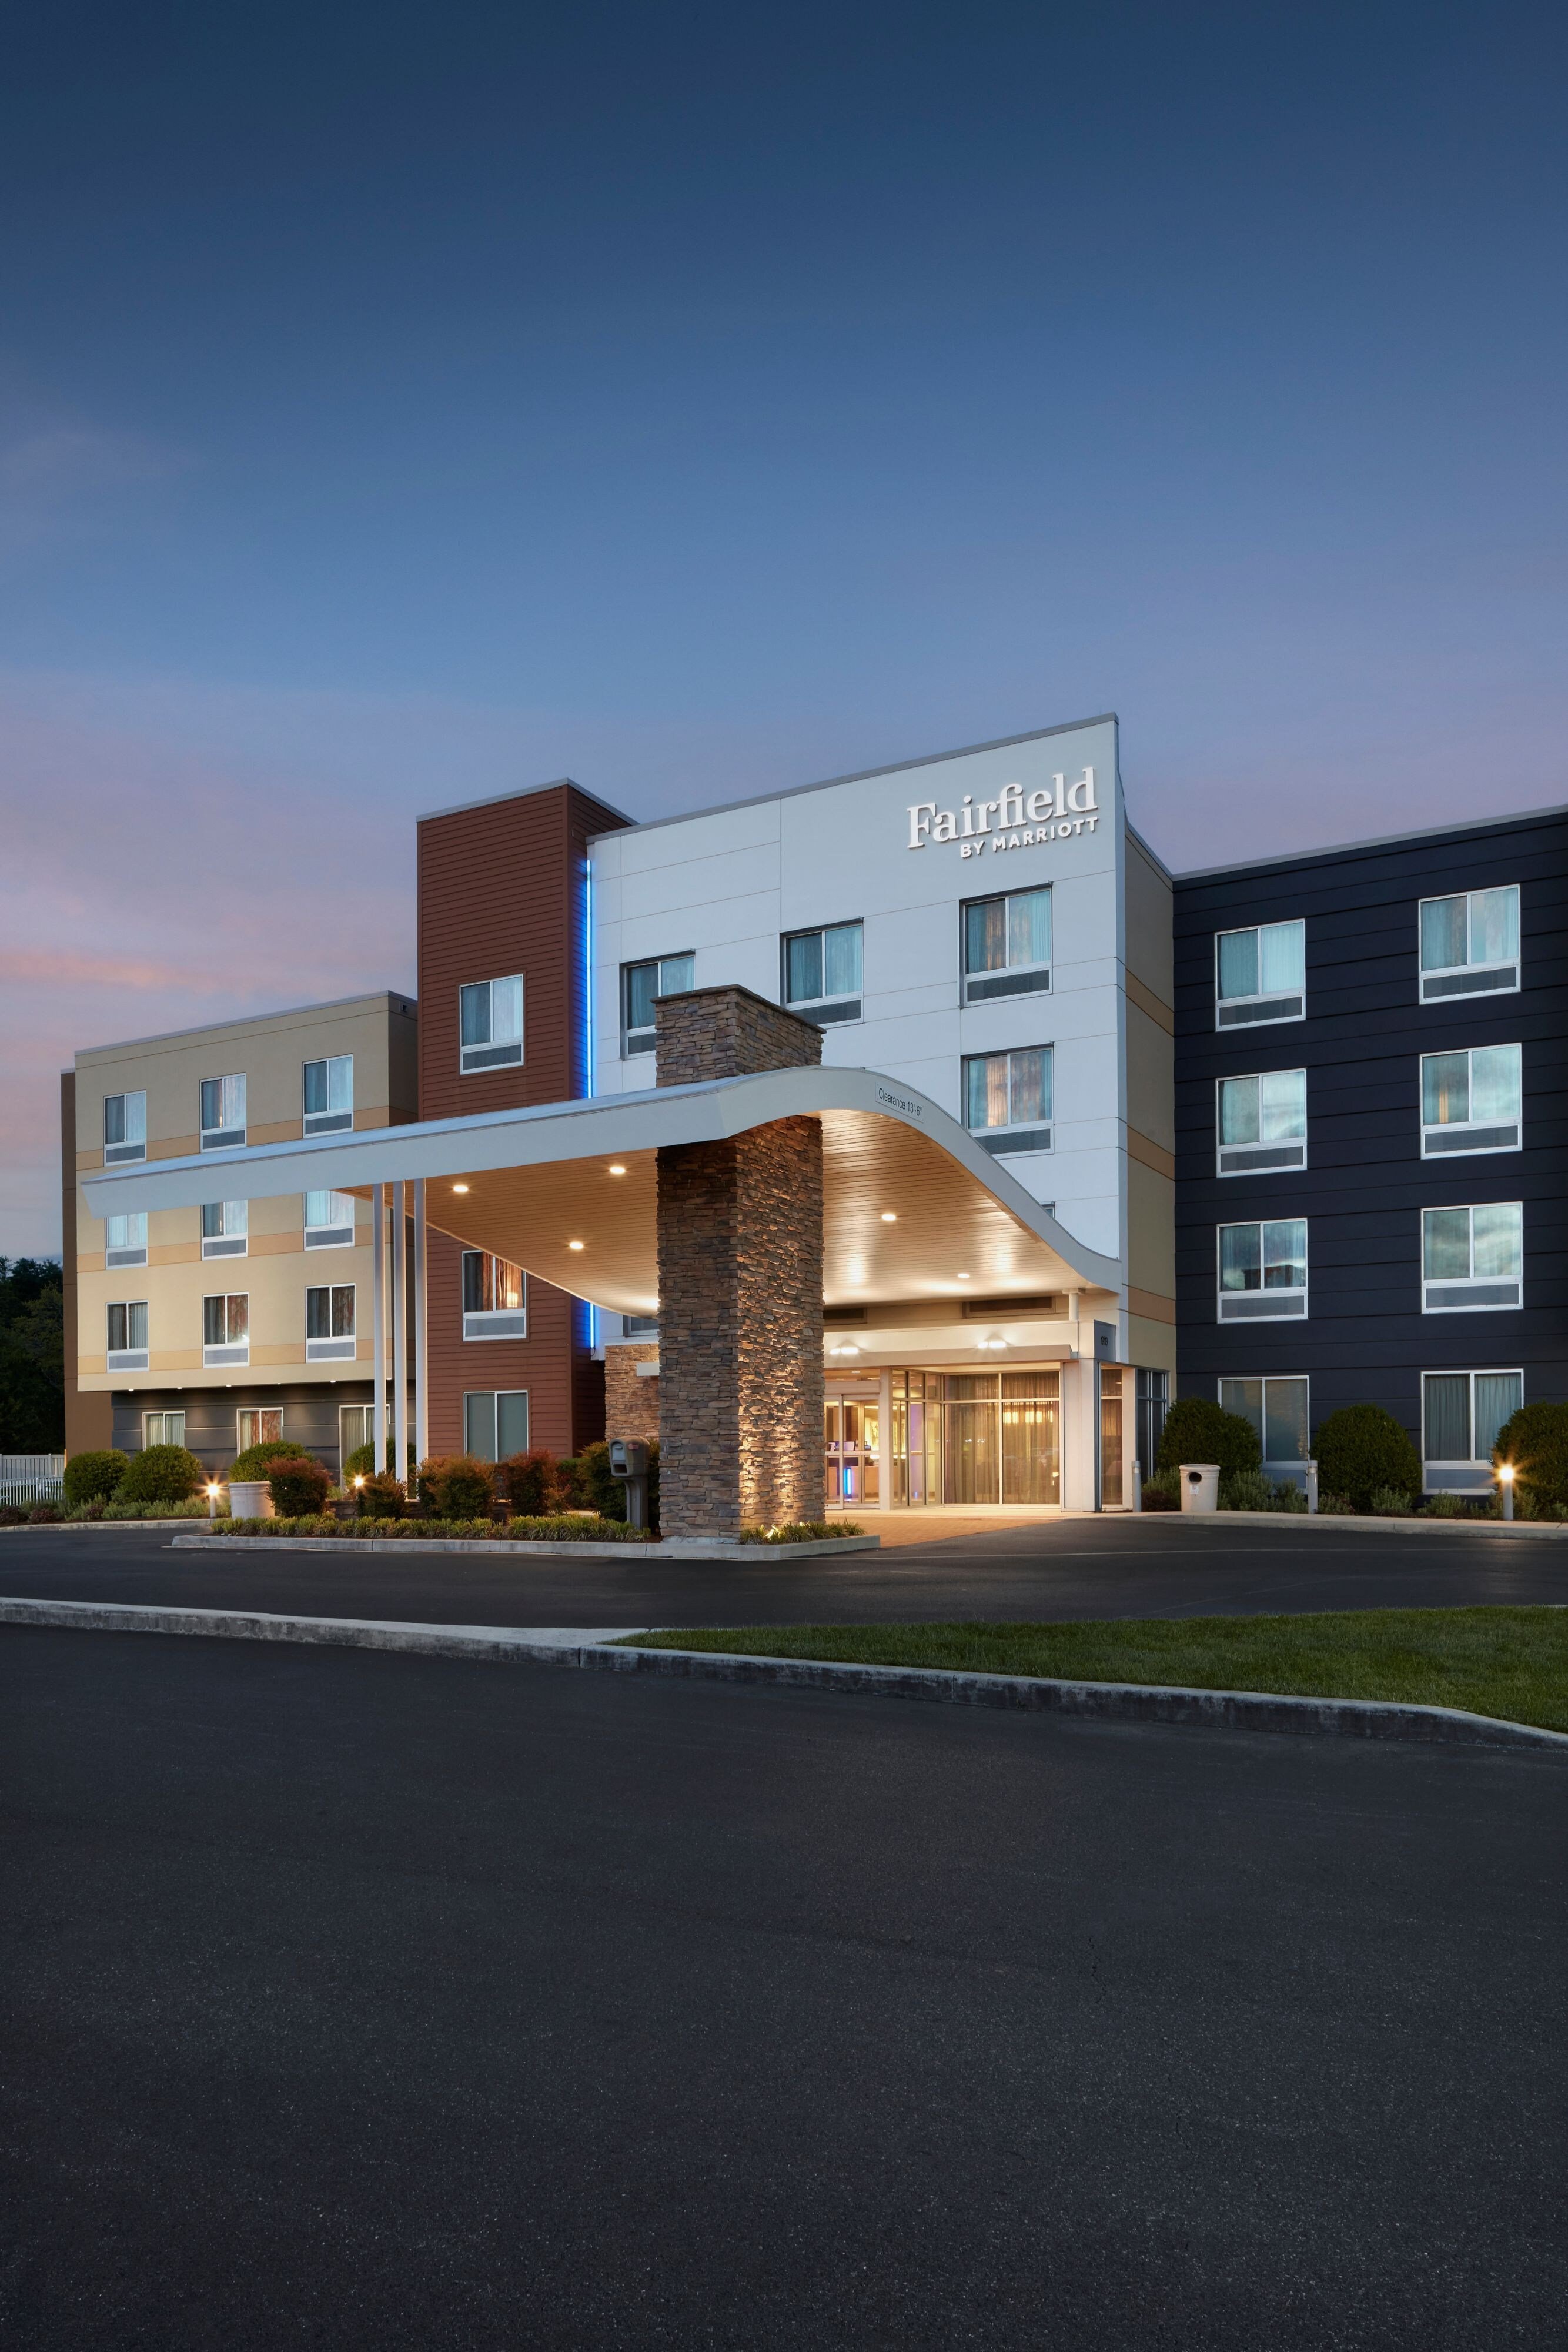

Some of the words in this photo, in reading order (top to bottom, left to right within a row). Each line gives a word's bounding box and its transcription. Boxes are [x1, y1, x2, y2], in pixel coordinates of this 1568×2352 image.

[907, 767, 1098, 848] Fairfield
[961, 841, 985, 858] BY
[993, 817, 1099, 852] MARRIOTT
[878, 1088, 905, 1110] Clearance
